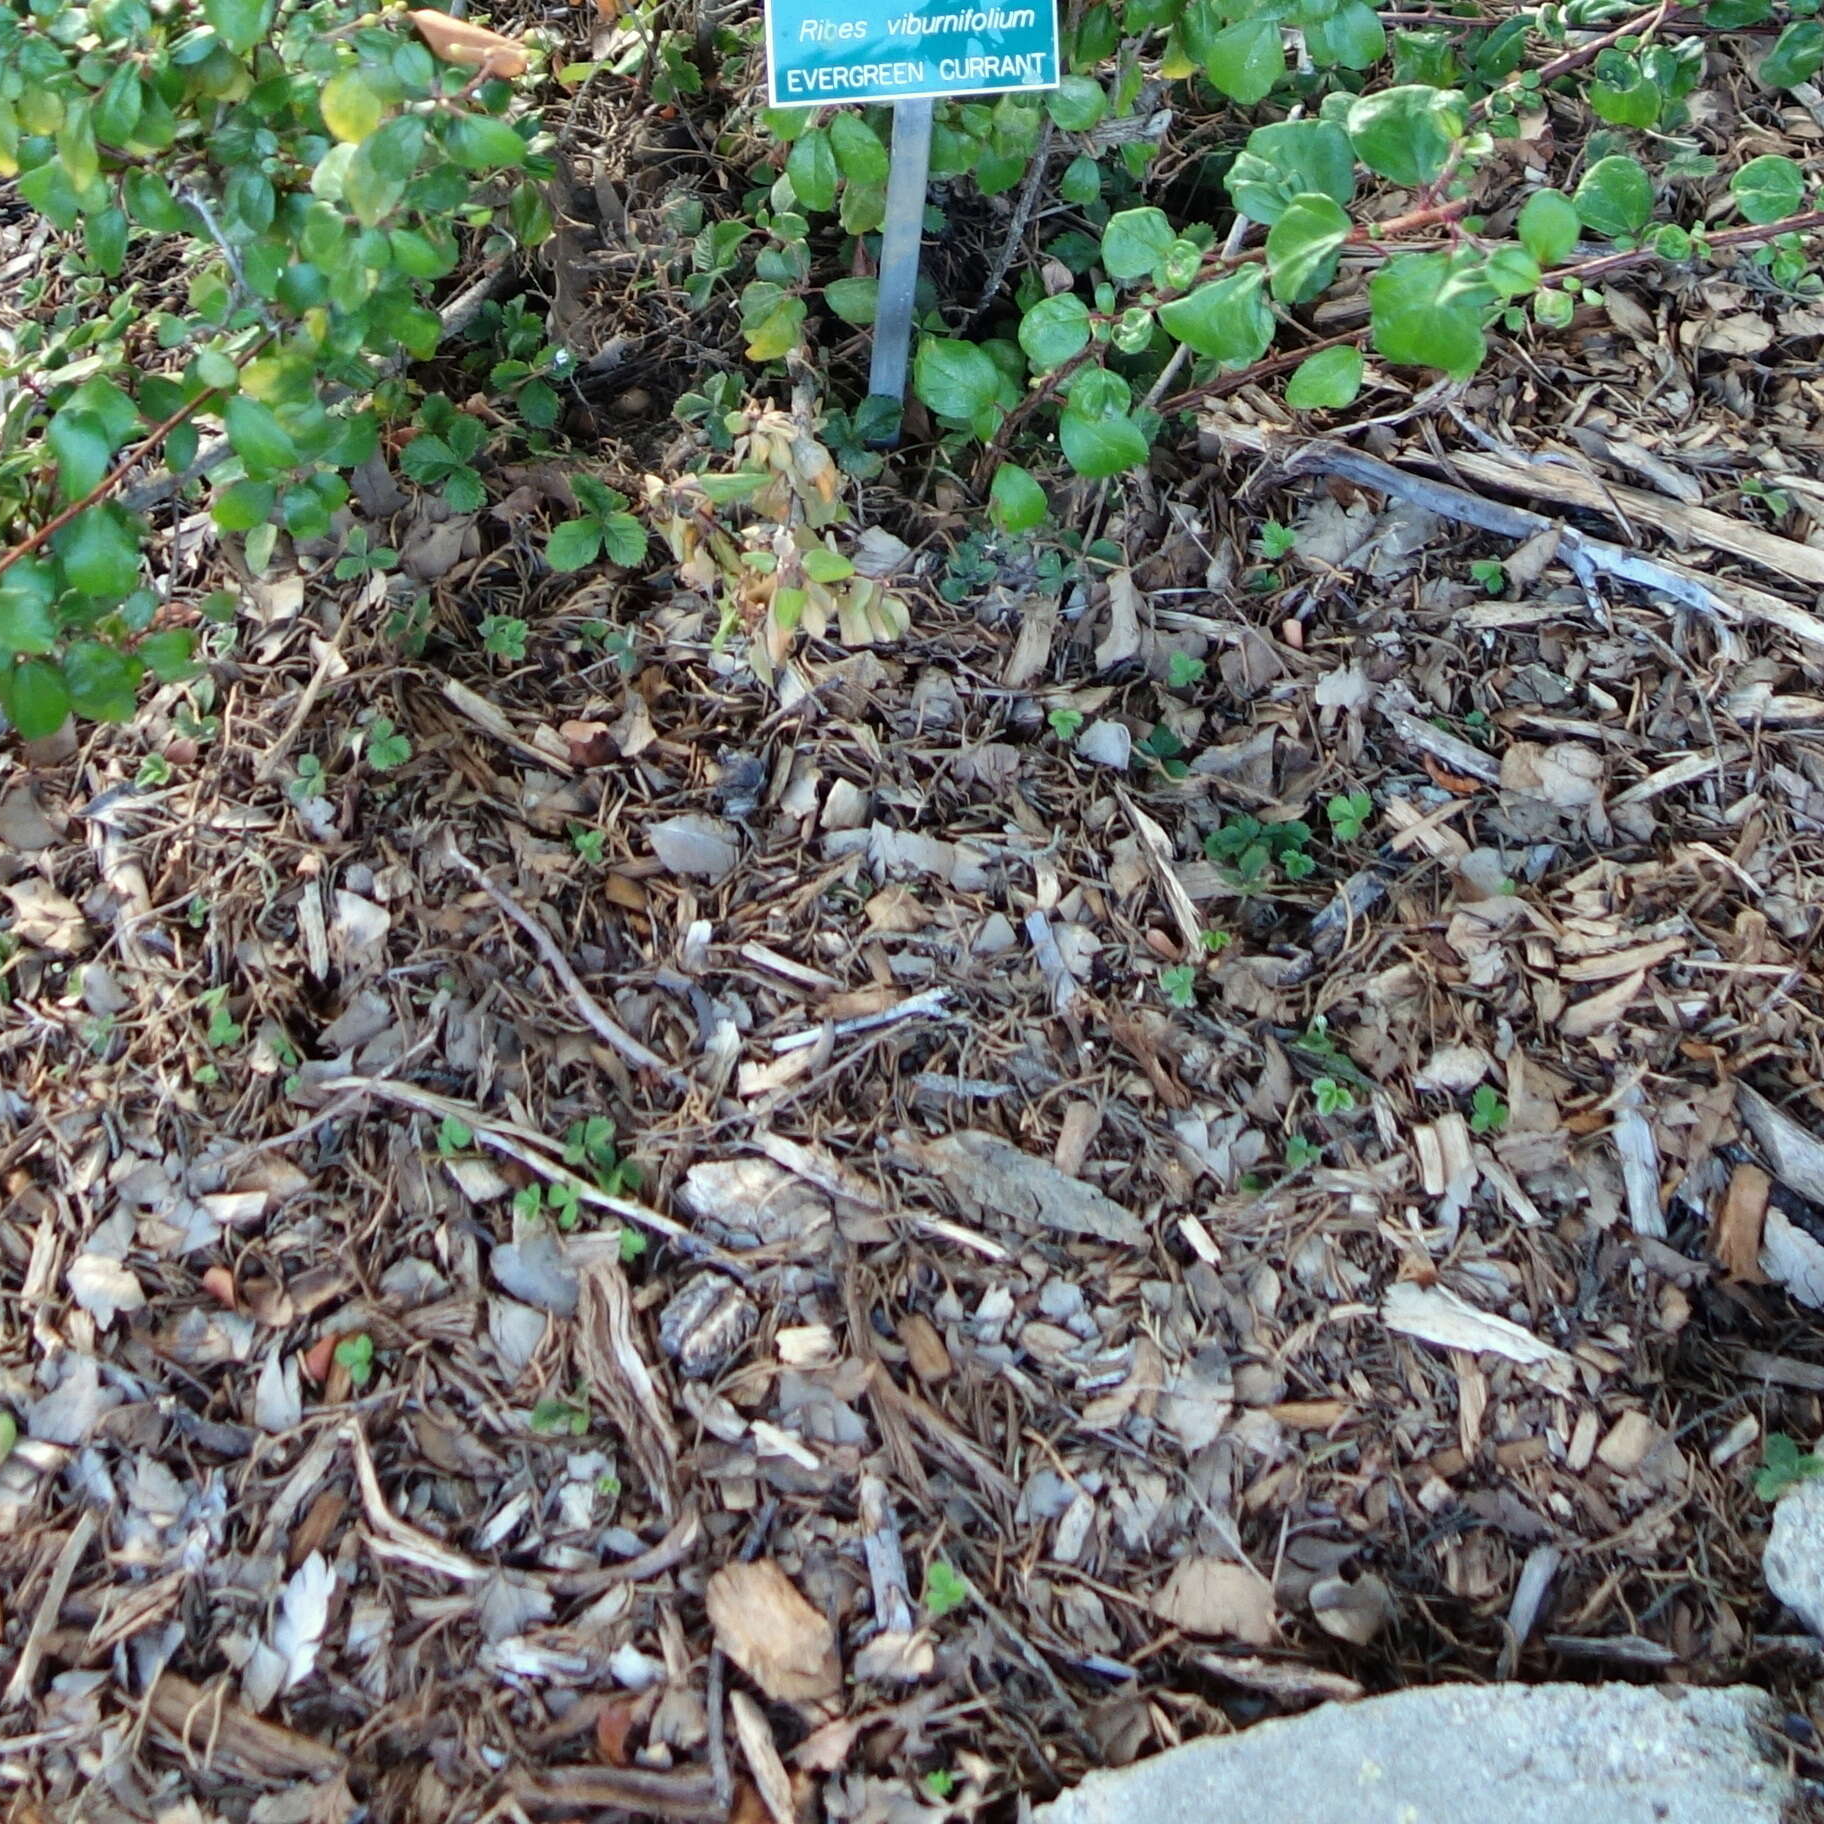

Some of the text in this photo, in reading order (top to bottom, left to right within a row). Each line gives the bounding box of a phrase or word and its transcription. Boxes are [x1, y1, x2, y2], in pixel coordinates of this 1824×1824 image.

[887, 7, 1036, 37] viburnifolium
[787, 52, 1047, 93] EVERGREEN CURRANT
